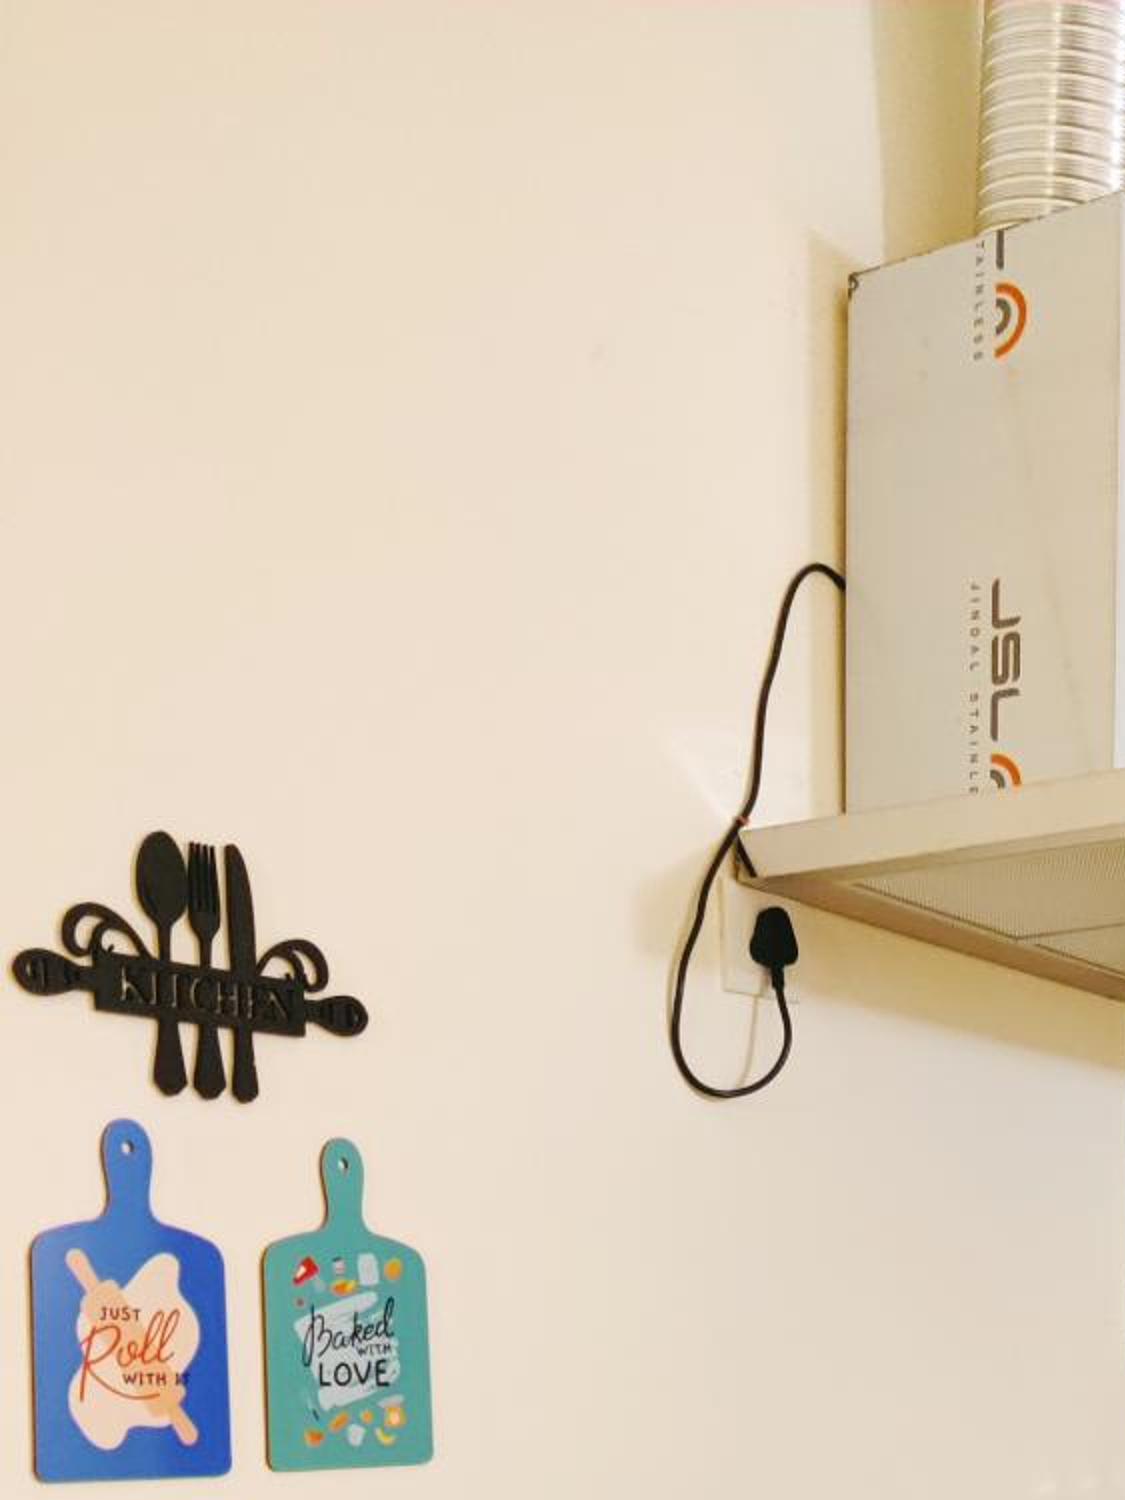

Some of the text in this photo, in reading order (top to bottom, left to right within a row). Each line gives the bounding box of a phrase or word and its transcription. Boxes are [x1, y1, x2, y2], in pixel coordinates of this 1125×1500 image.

[969, 584, 981, 672] JINDAL
[991, 578, 1021, 741] JSL
[109, 965, 295, 1026] KITCHEN
[100, 1306, 140, 1321] JUST
[302, 1296, 395, 1367] Baked
[79, 1308, 181, 1402] Roll
[122, 1371, 166, 1386] WITH
[319, 1359, 390, 1387] LOVE
[357, 1342, 392, 1357] WITH
